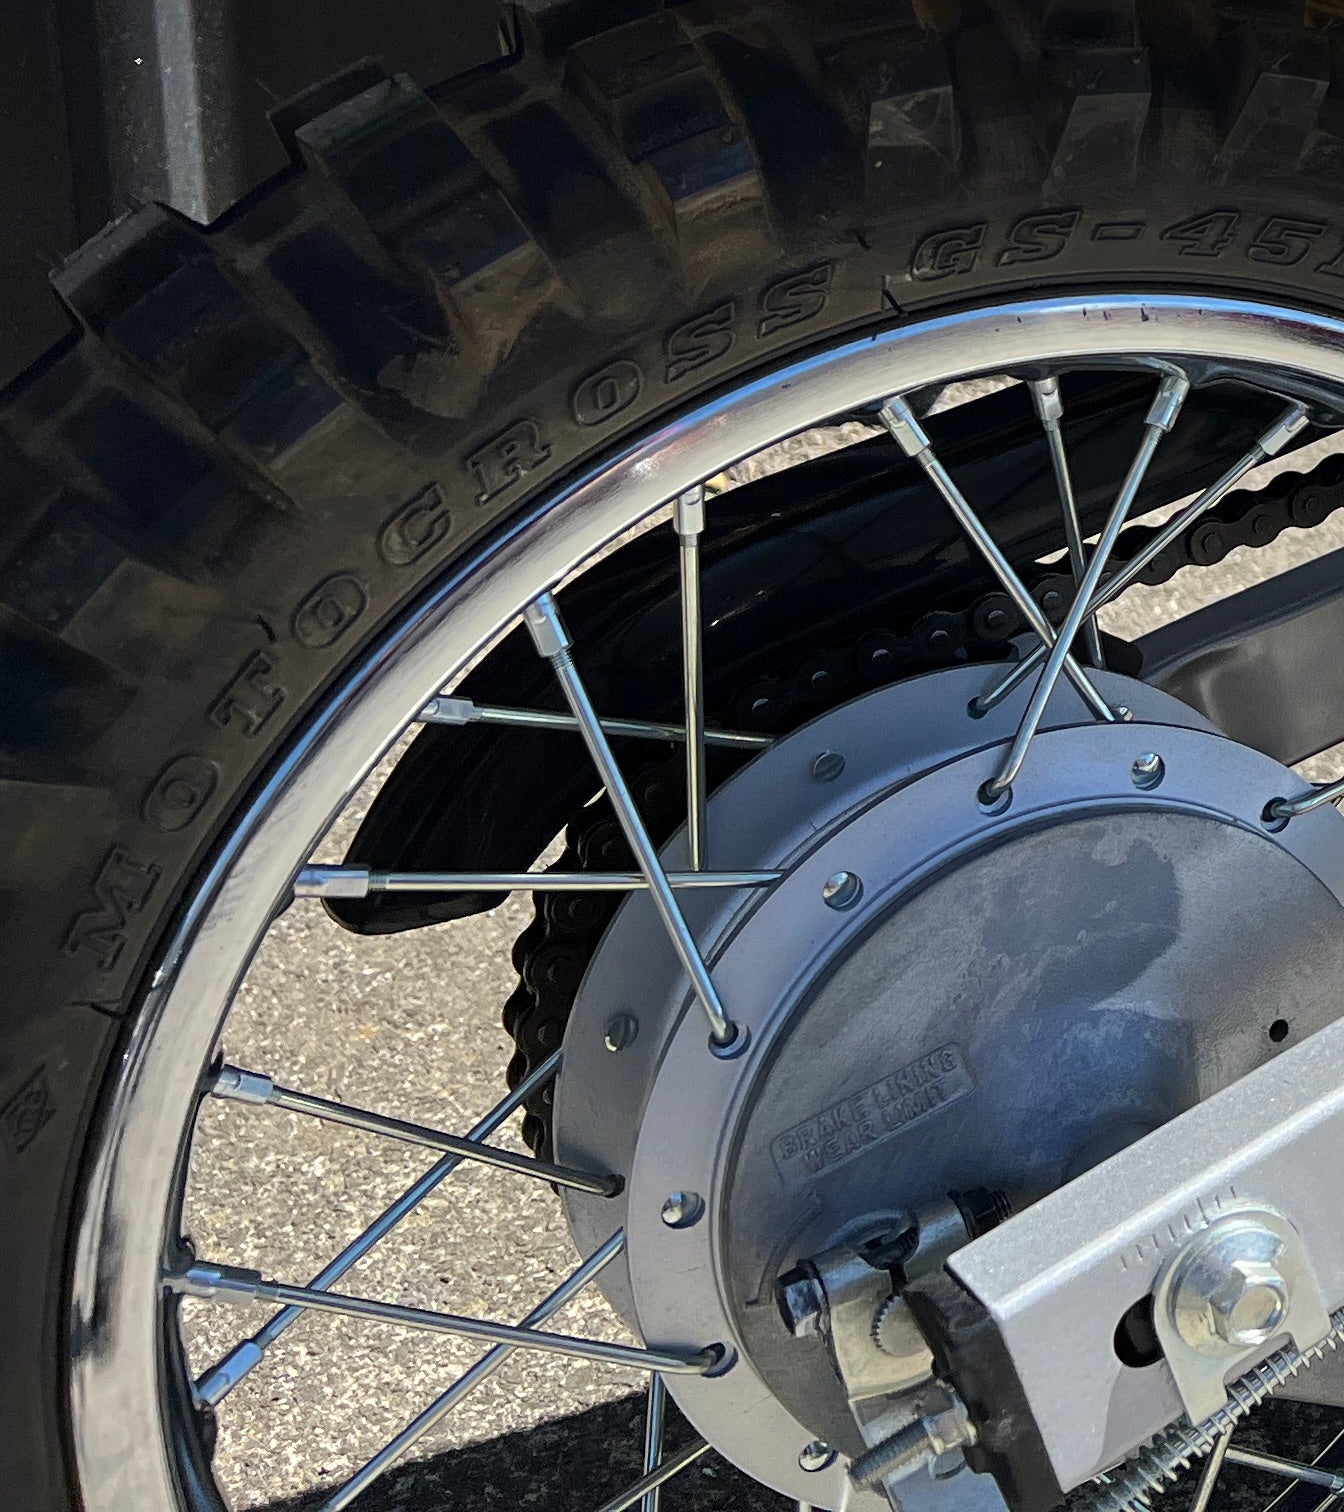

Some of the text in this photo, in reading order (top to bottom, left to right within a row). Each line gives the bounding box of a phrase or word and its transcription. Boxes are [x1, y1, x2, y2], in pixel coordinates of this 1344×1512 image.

[61, 264, 836, 971] MOTOCROSS
[779, 1047, 959, 1161] BRAKE LINING
[800, 1079, 949, 1172] WEAR LIMIT
